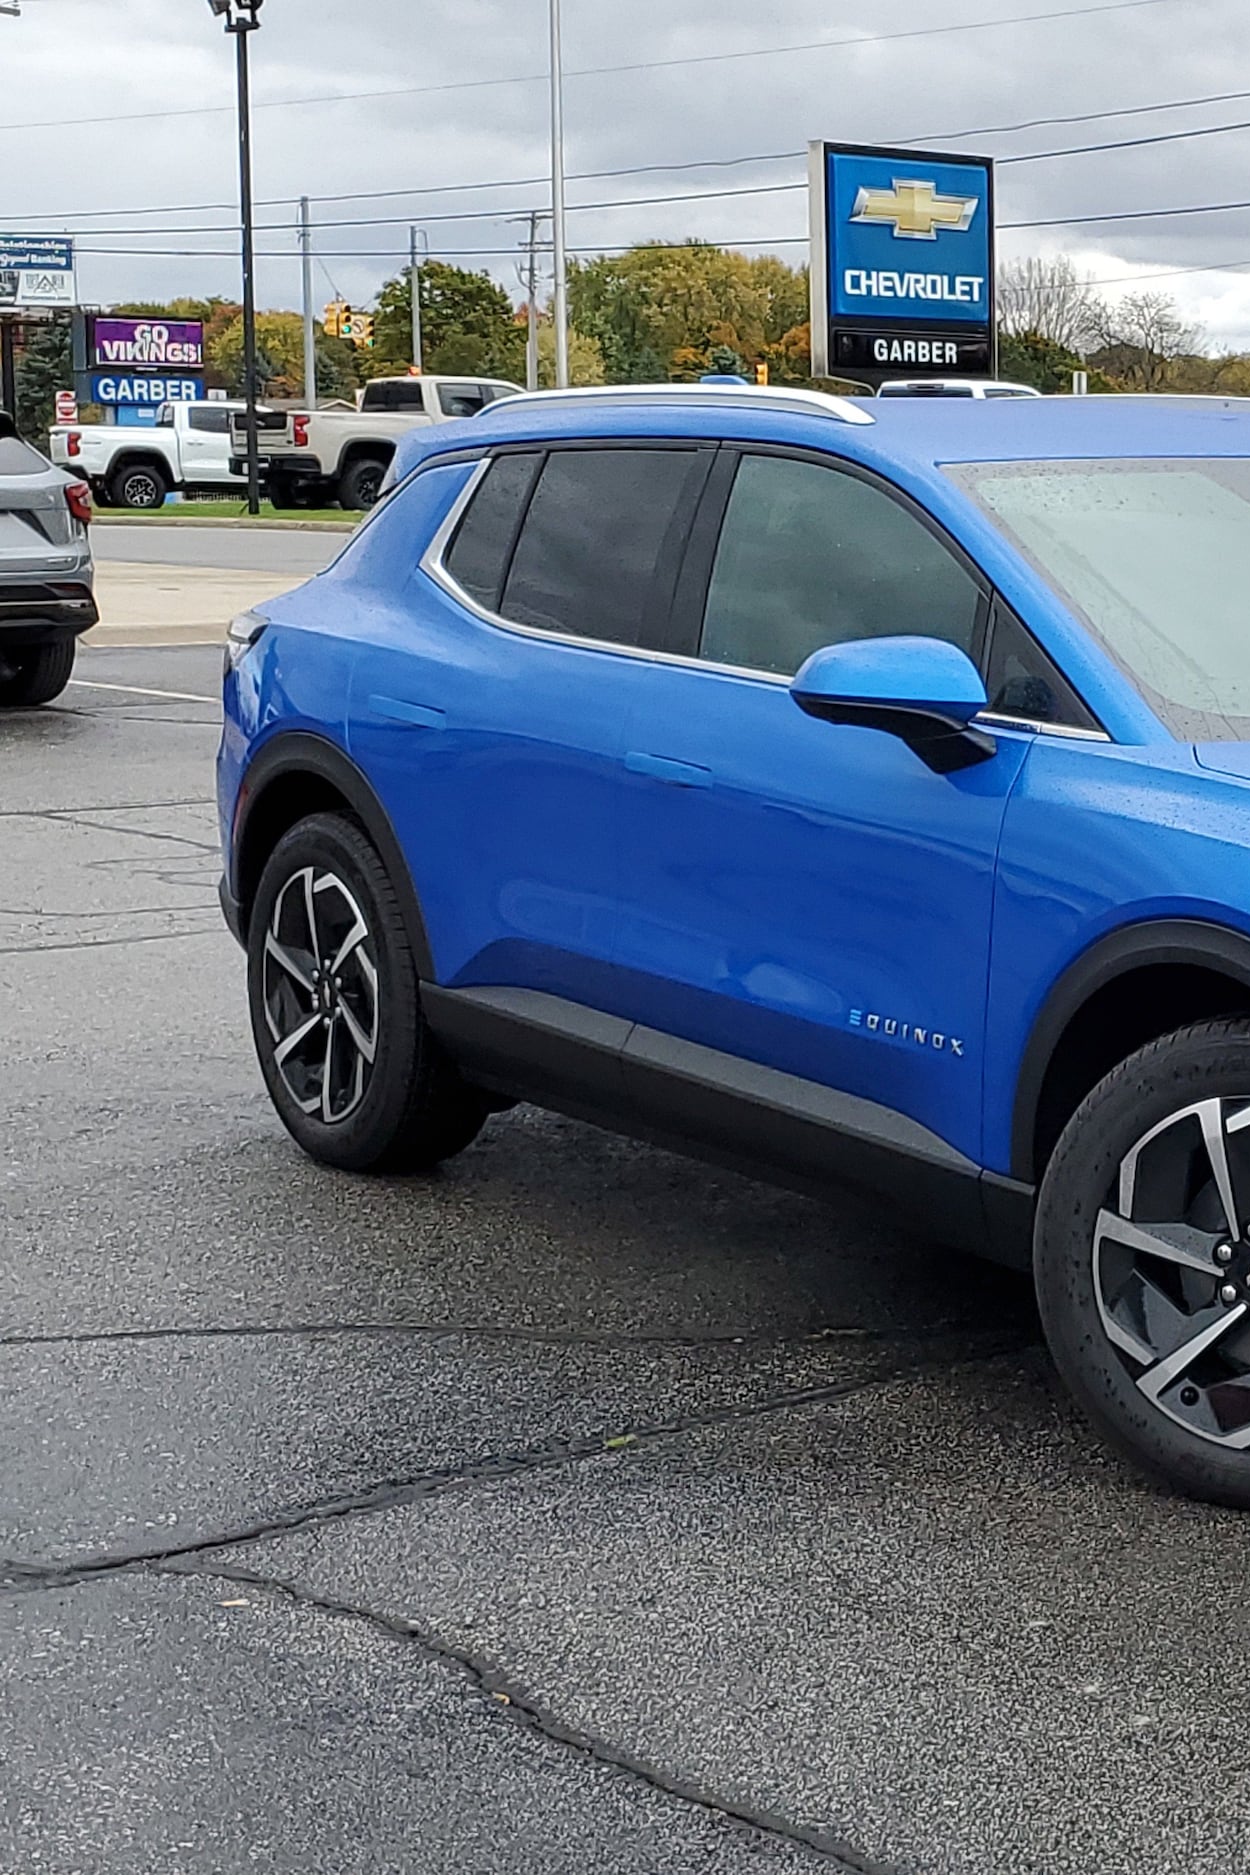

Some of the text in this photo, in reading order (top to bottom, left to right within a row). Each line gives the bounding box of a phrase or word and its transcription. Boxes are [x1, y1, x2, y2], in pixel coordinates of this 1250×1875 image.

[844, 269, 984, 302] CHEVROLET
[134, 325, 169, 343] GO
[874, 339, 958, 364] GARBER
[98, 378, 196, 401] GARBER
[849, 1009, 963, 1056] EQUINOX
